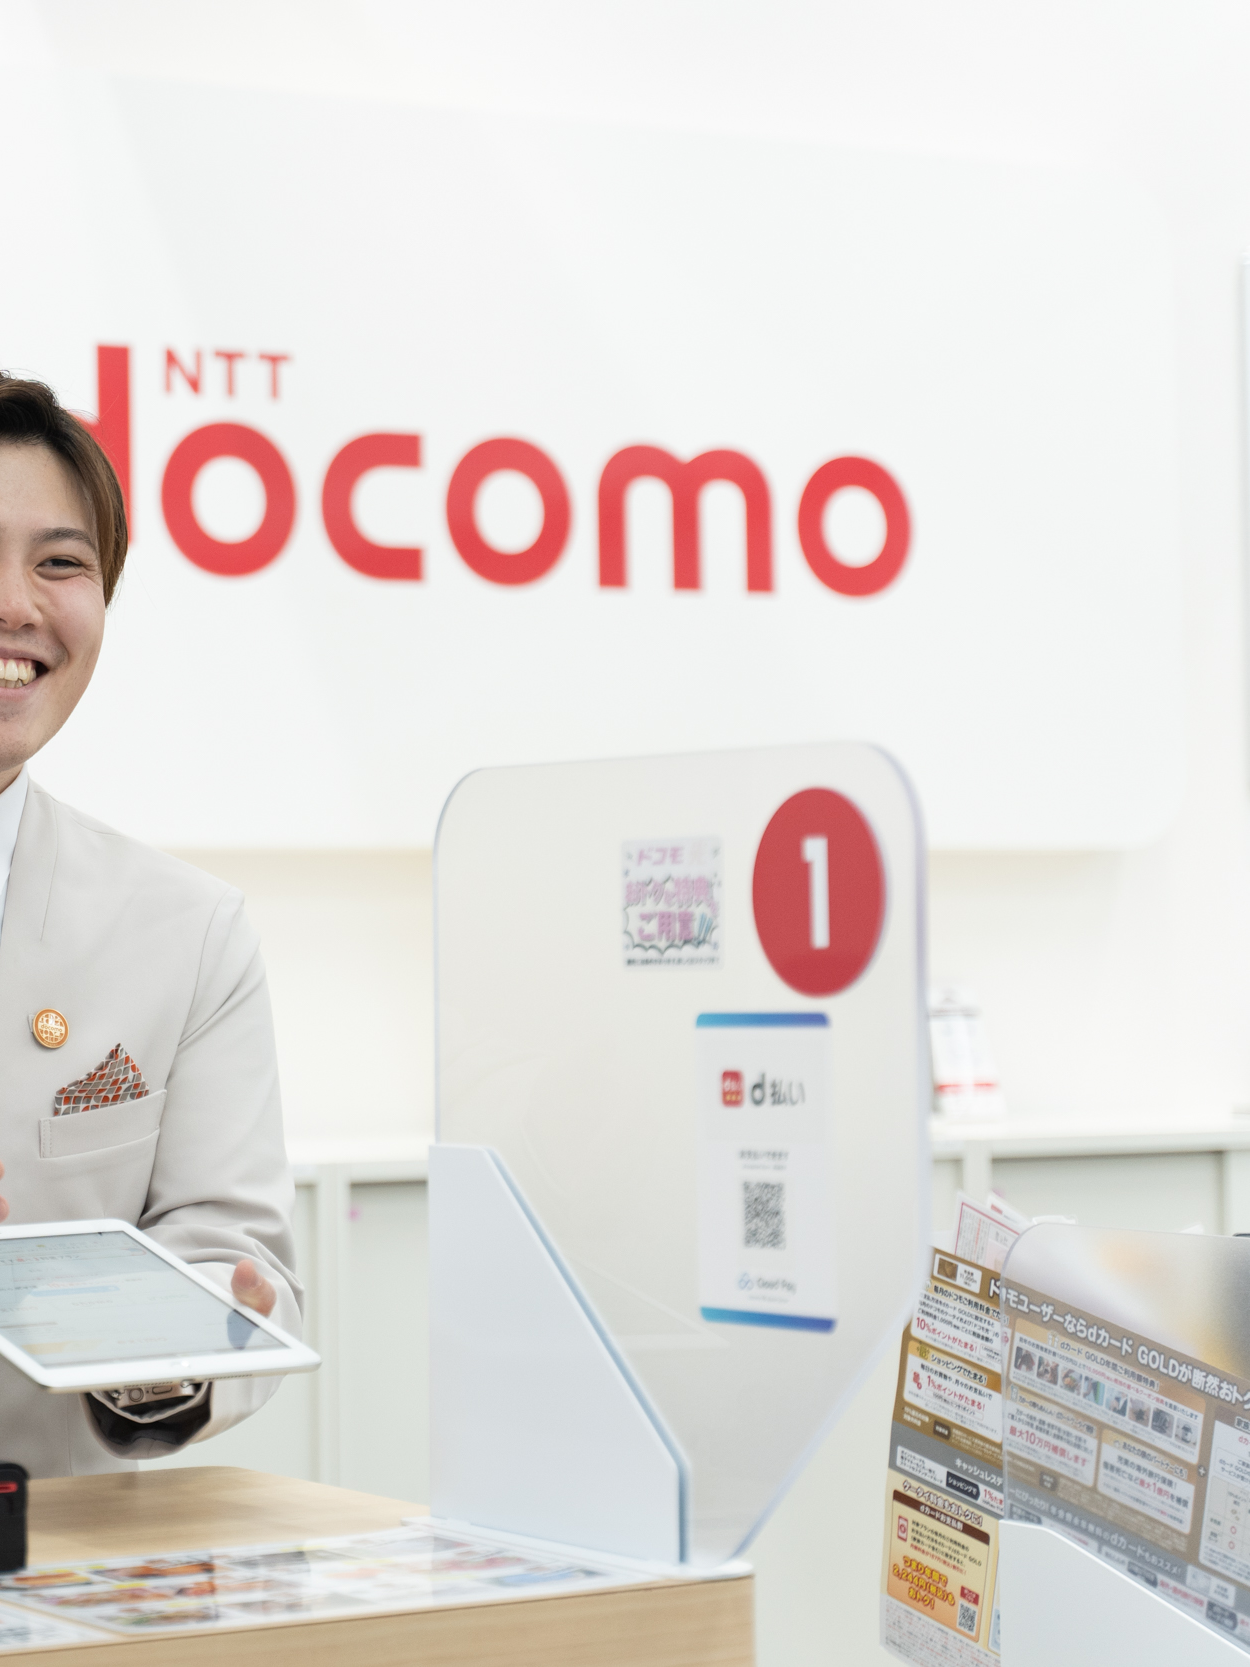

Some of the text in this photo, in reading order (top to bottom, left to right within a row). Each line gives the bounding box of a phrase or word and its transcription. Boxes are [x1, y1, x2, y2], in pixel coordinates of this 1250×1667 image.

[162, 346, 292, 399] NTT
[802, 835, 830, 950] 1
[40, 1024, 63, 1033] docomo
[750, 1072, 806, 1107] d払い
[931, 1353, 988, 1385] ショッピングでたまる!
[927, 1375, 986, 1412] 1%ポイントがたまる!
[902, 1479, 983, 1528] ケータイ料金もおトクに!
[919, 1504, 964, 1532] dカードお支払割
[892, 1562, 956, 1607] 2,244円(税込)も
[902, 1554, 949, 1588] つまり年間で
[908, 1586, 936, 1611] おトク!
